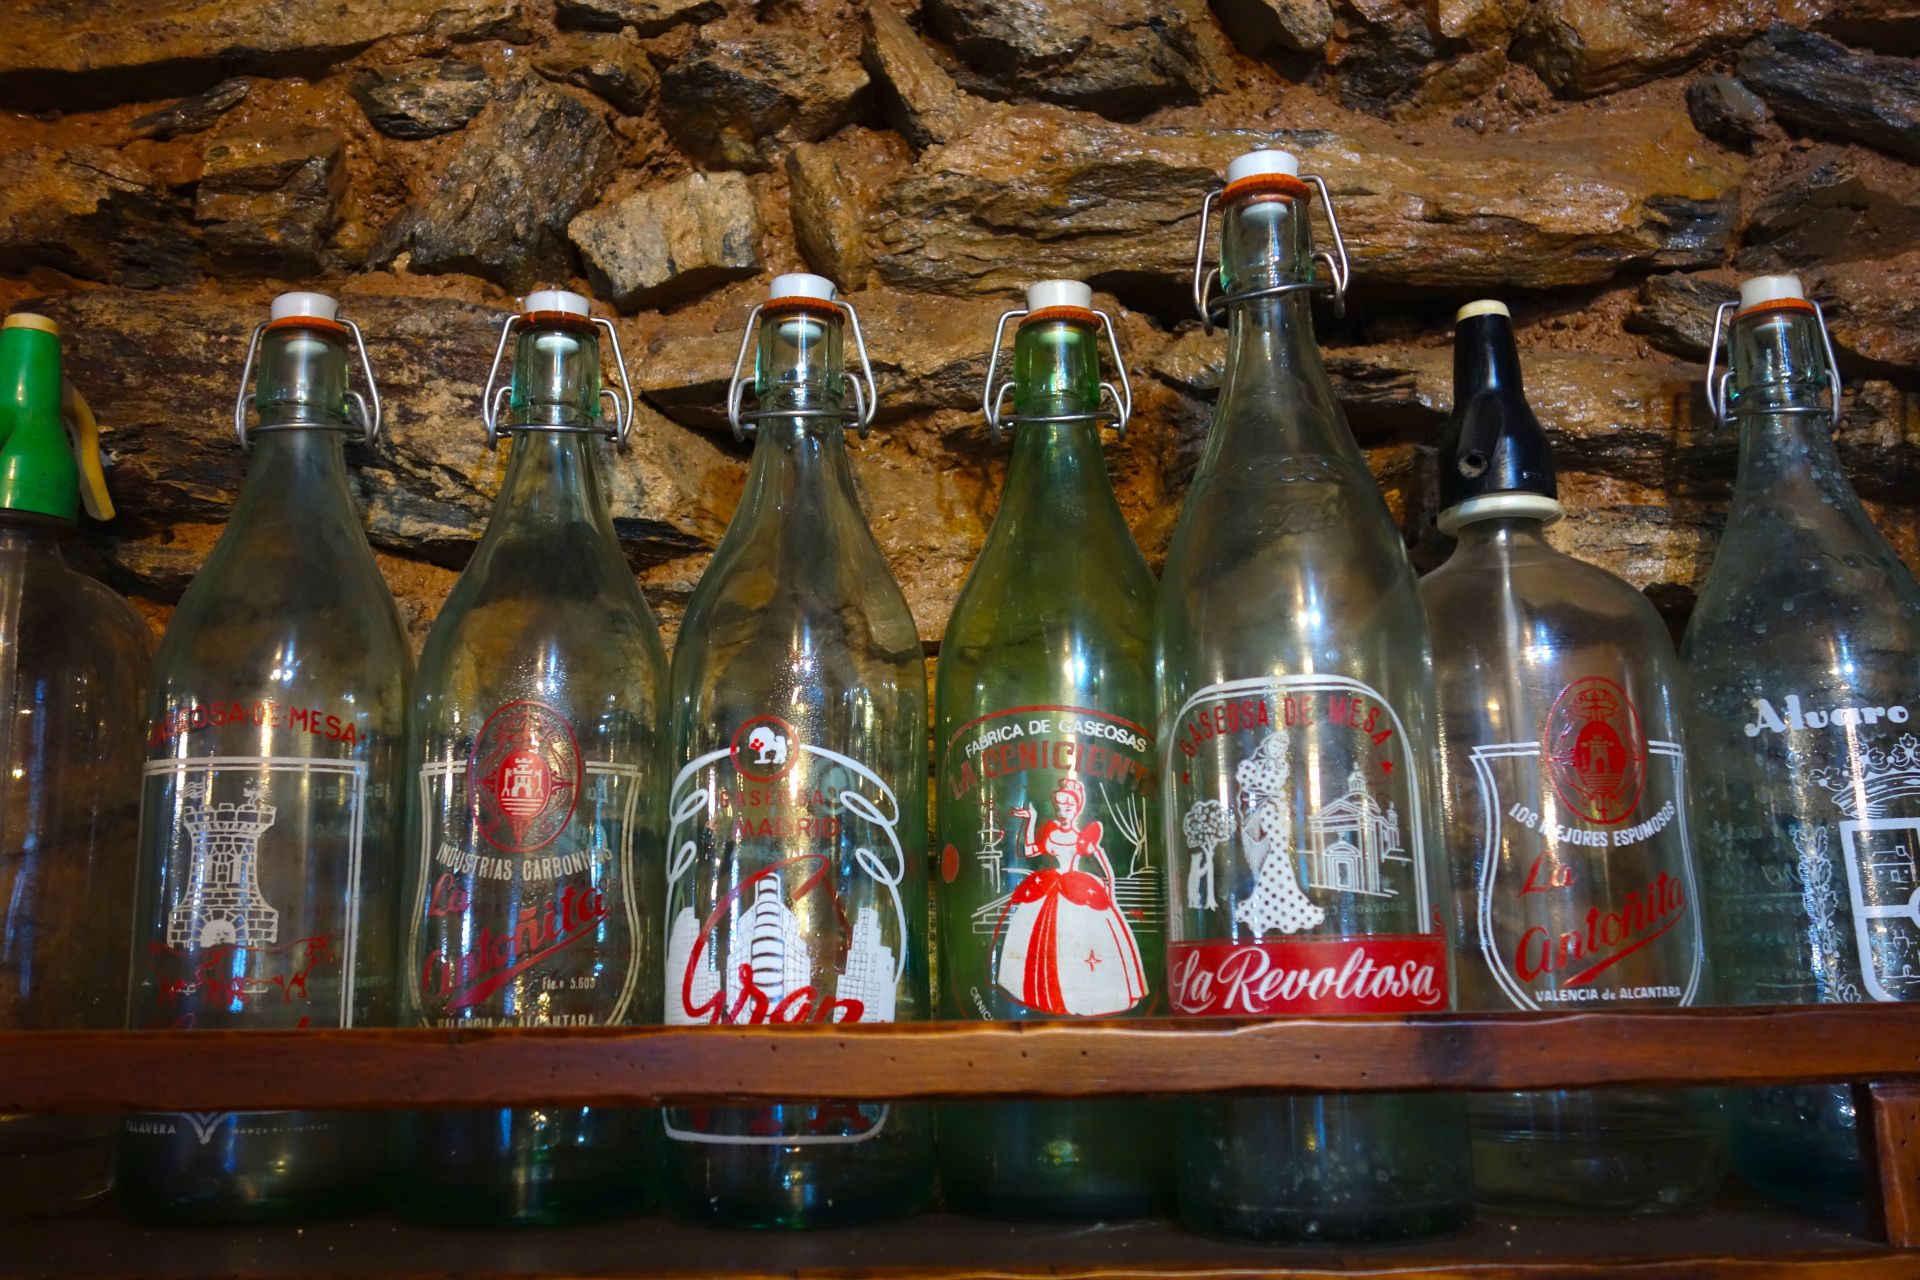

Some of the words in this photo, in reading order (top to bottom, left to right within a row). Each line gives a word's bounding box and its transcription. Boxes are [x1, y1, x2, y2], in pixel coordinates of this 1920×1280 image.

[289, 707, 357, 747] MESA
[1179, 700, 1270, 757] GASEOSA
[1284, 696, 1314, 727] DE
[1329, 695, 1393, 748] MESA
[1744, 694, 1909, 737] Alvaro
[964, 723, 1024, 759] FABRICA
[1028, 720, 1051, 735] DE
[1058, 720, 1147, 752] GASEOSAS
[948, 760, 977, 800] LA
[735, 816, 841, 838] MADRID
[1508, 802, 1539, 829] LOS
[1538, 822, 1609, 847] MEJORES
[1613, 800, 1676, 847] ESPUMOSOS
[436, 843, 512, 881] INDUSTRIAS
[1516, 850, 1575, 898] La
[429, 872, 470, 918] La
[1172, 949, 1217, 1014] La
[1217, 946, 1441, 1014] Revoltosa
[1535, 988, 1600, 1002] VALENCIA
[1602, 988, 1616, 1000] de
[1620, 986, 1682, 1000] ALCANTARA
